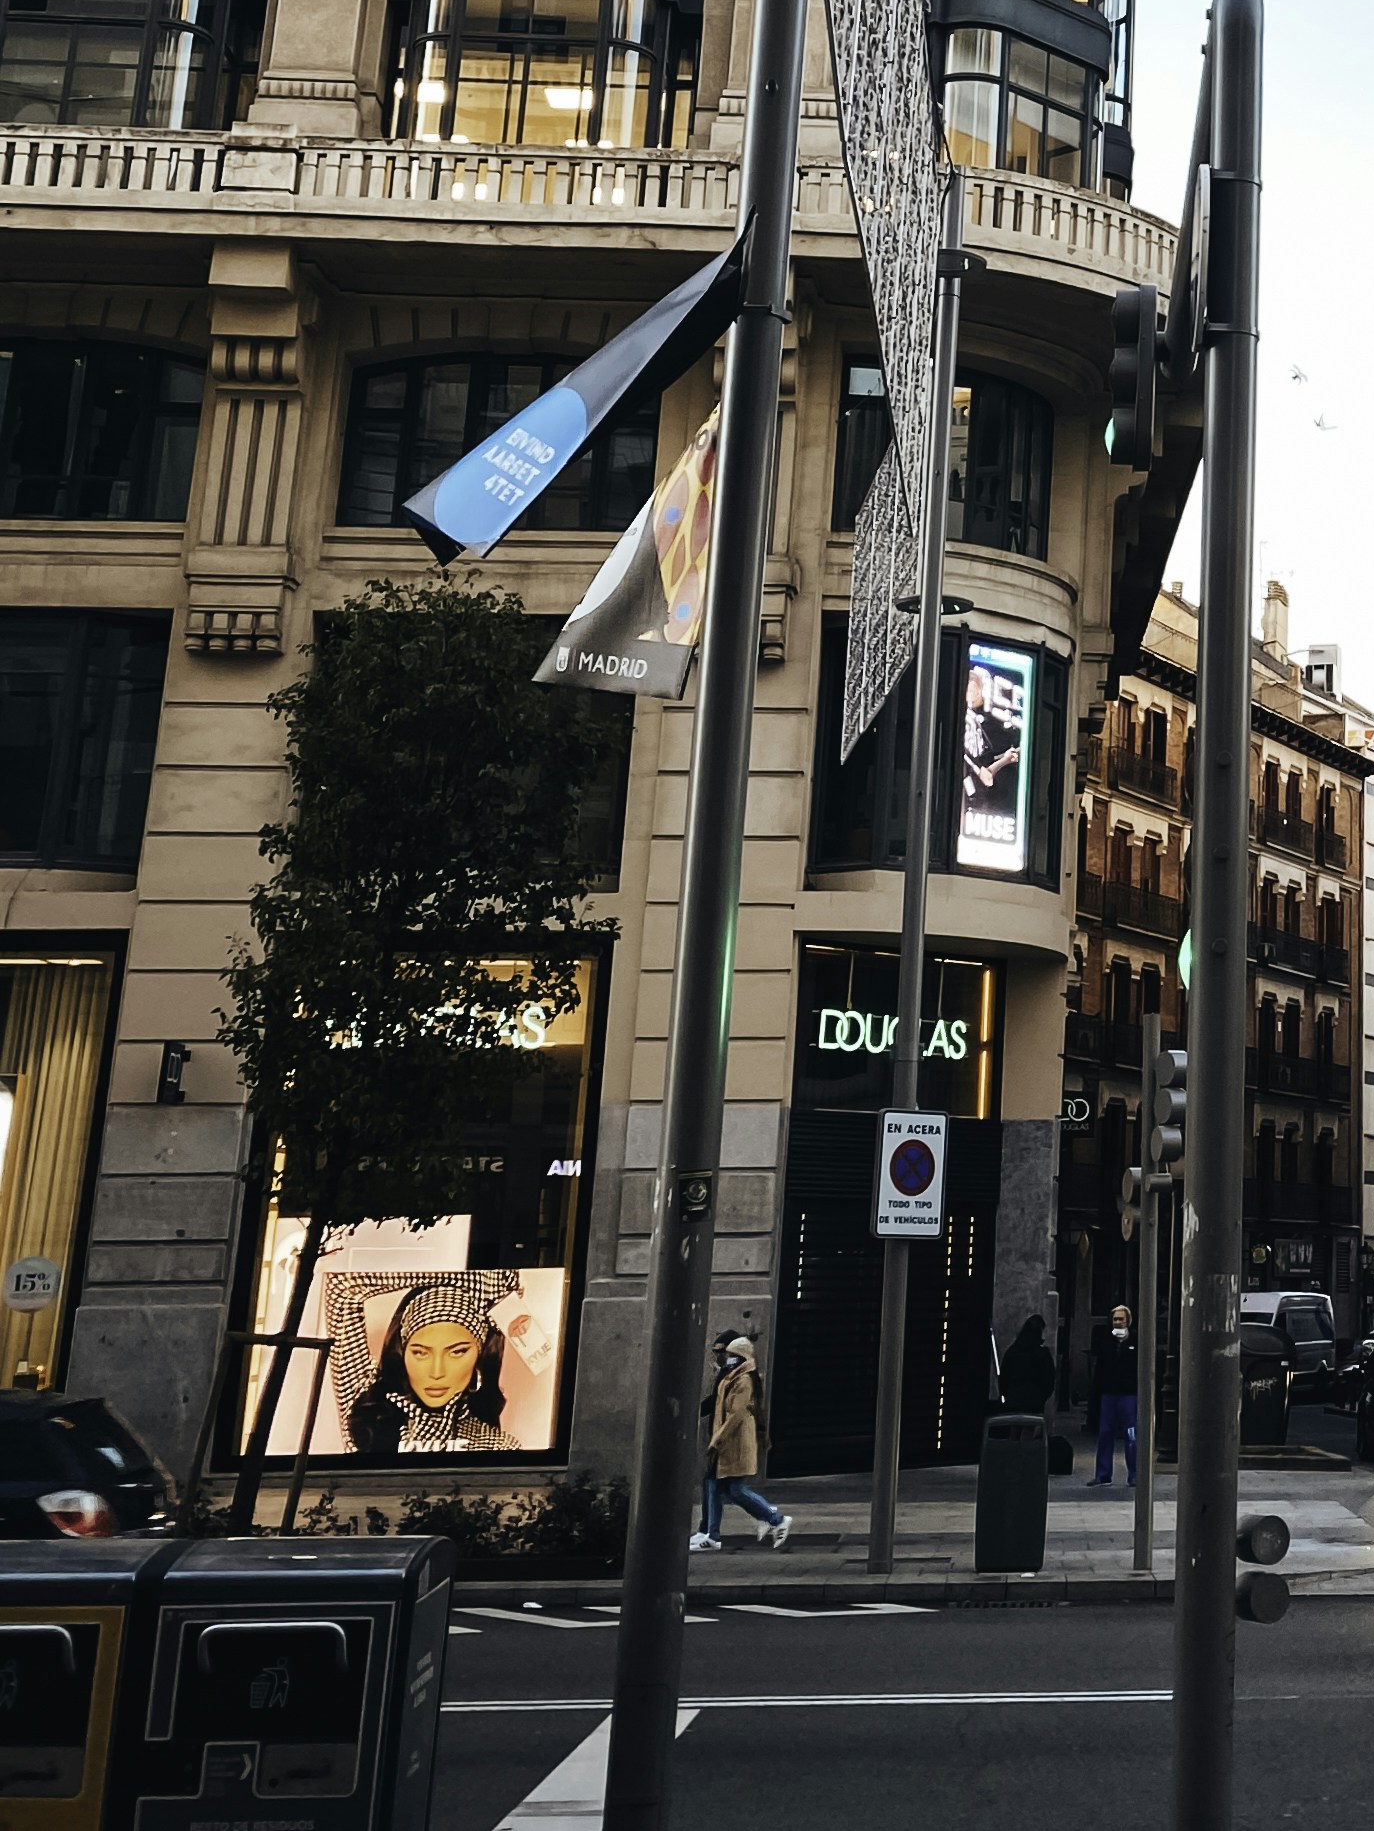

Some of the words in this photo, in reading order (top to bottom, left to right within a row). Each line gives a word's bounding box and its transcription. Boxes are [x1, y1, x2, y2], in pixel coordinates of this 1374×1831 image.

[578, 651, 649, 679] MADRID
[965, 811, 1016, 841] MUSE
[818, 1008, 968, 1060] DOUAS
[887, 1123, 902, 1134] EN
[906, 1124, 942, 1136] ACERA
[888, 1200, 910, 1209] TODO
[914, 1200, 933, 1209] TIPO
[878, 1215, 890, 1224] DE
[14, 1272, 52, 1292] 15%
